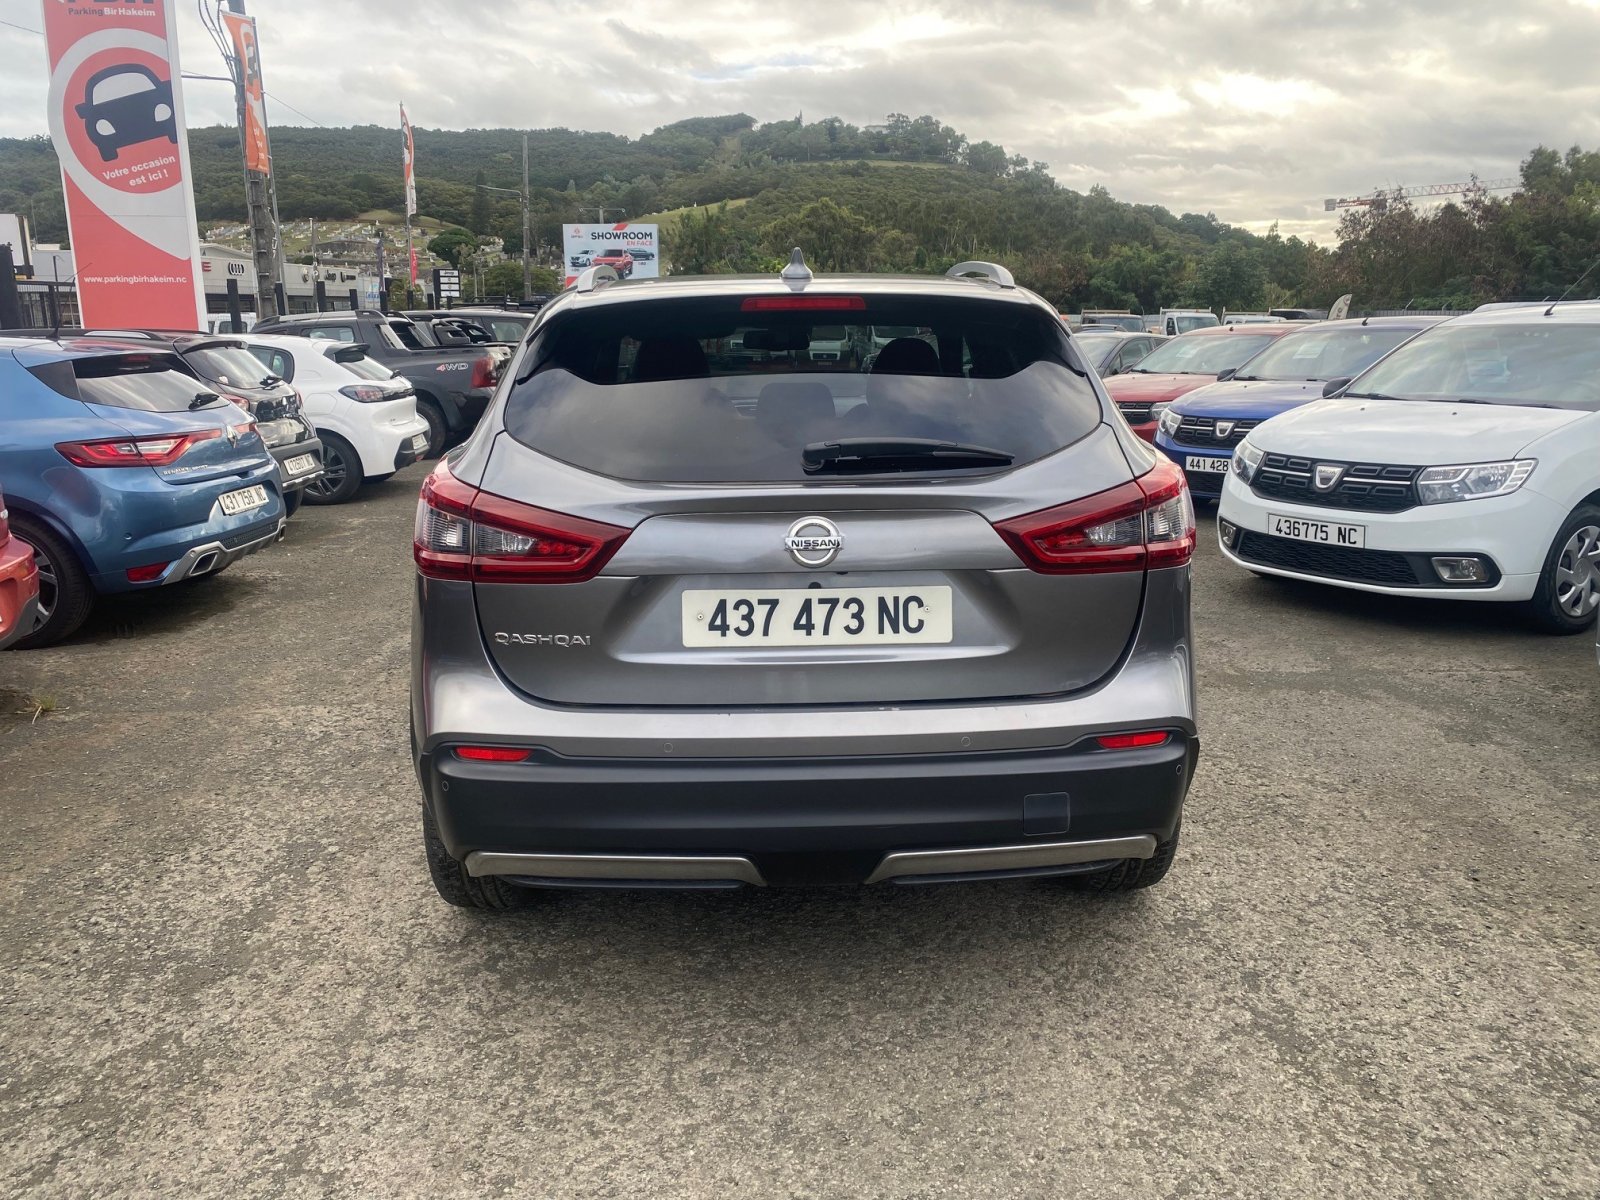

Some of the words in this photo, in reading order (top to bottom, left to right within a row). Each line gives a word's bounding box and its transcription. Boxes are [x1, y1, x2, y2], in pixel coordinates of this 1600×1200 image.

[102, 168, 130, 180] Votre
[131, 155, 176, 173] occasion
[129, 175, 147, 186] est
[148, 170, 163, 181] ici
[591, 231, 653, 240] SHOWROOM
[84, 275, 187, 285] www.parkingbirhakeim.nc
[435, 362, 469, 372] 4WD
[1189, 458, 1206, 470] 441
[1210, 459, 1229, 472] 428
[254, 486, 267, 502] NC
[1275, 518, 1329, 541] 436775
[1337, 526, 1358, 545] NC
[791, 539, 837, 548] NISSAN
[708, 598, 780, 638] 437
[793, 597, 865, 637] 473
[877, 595, 925, 634] NC
